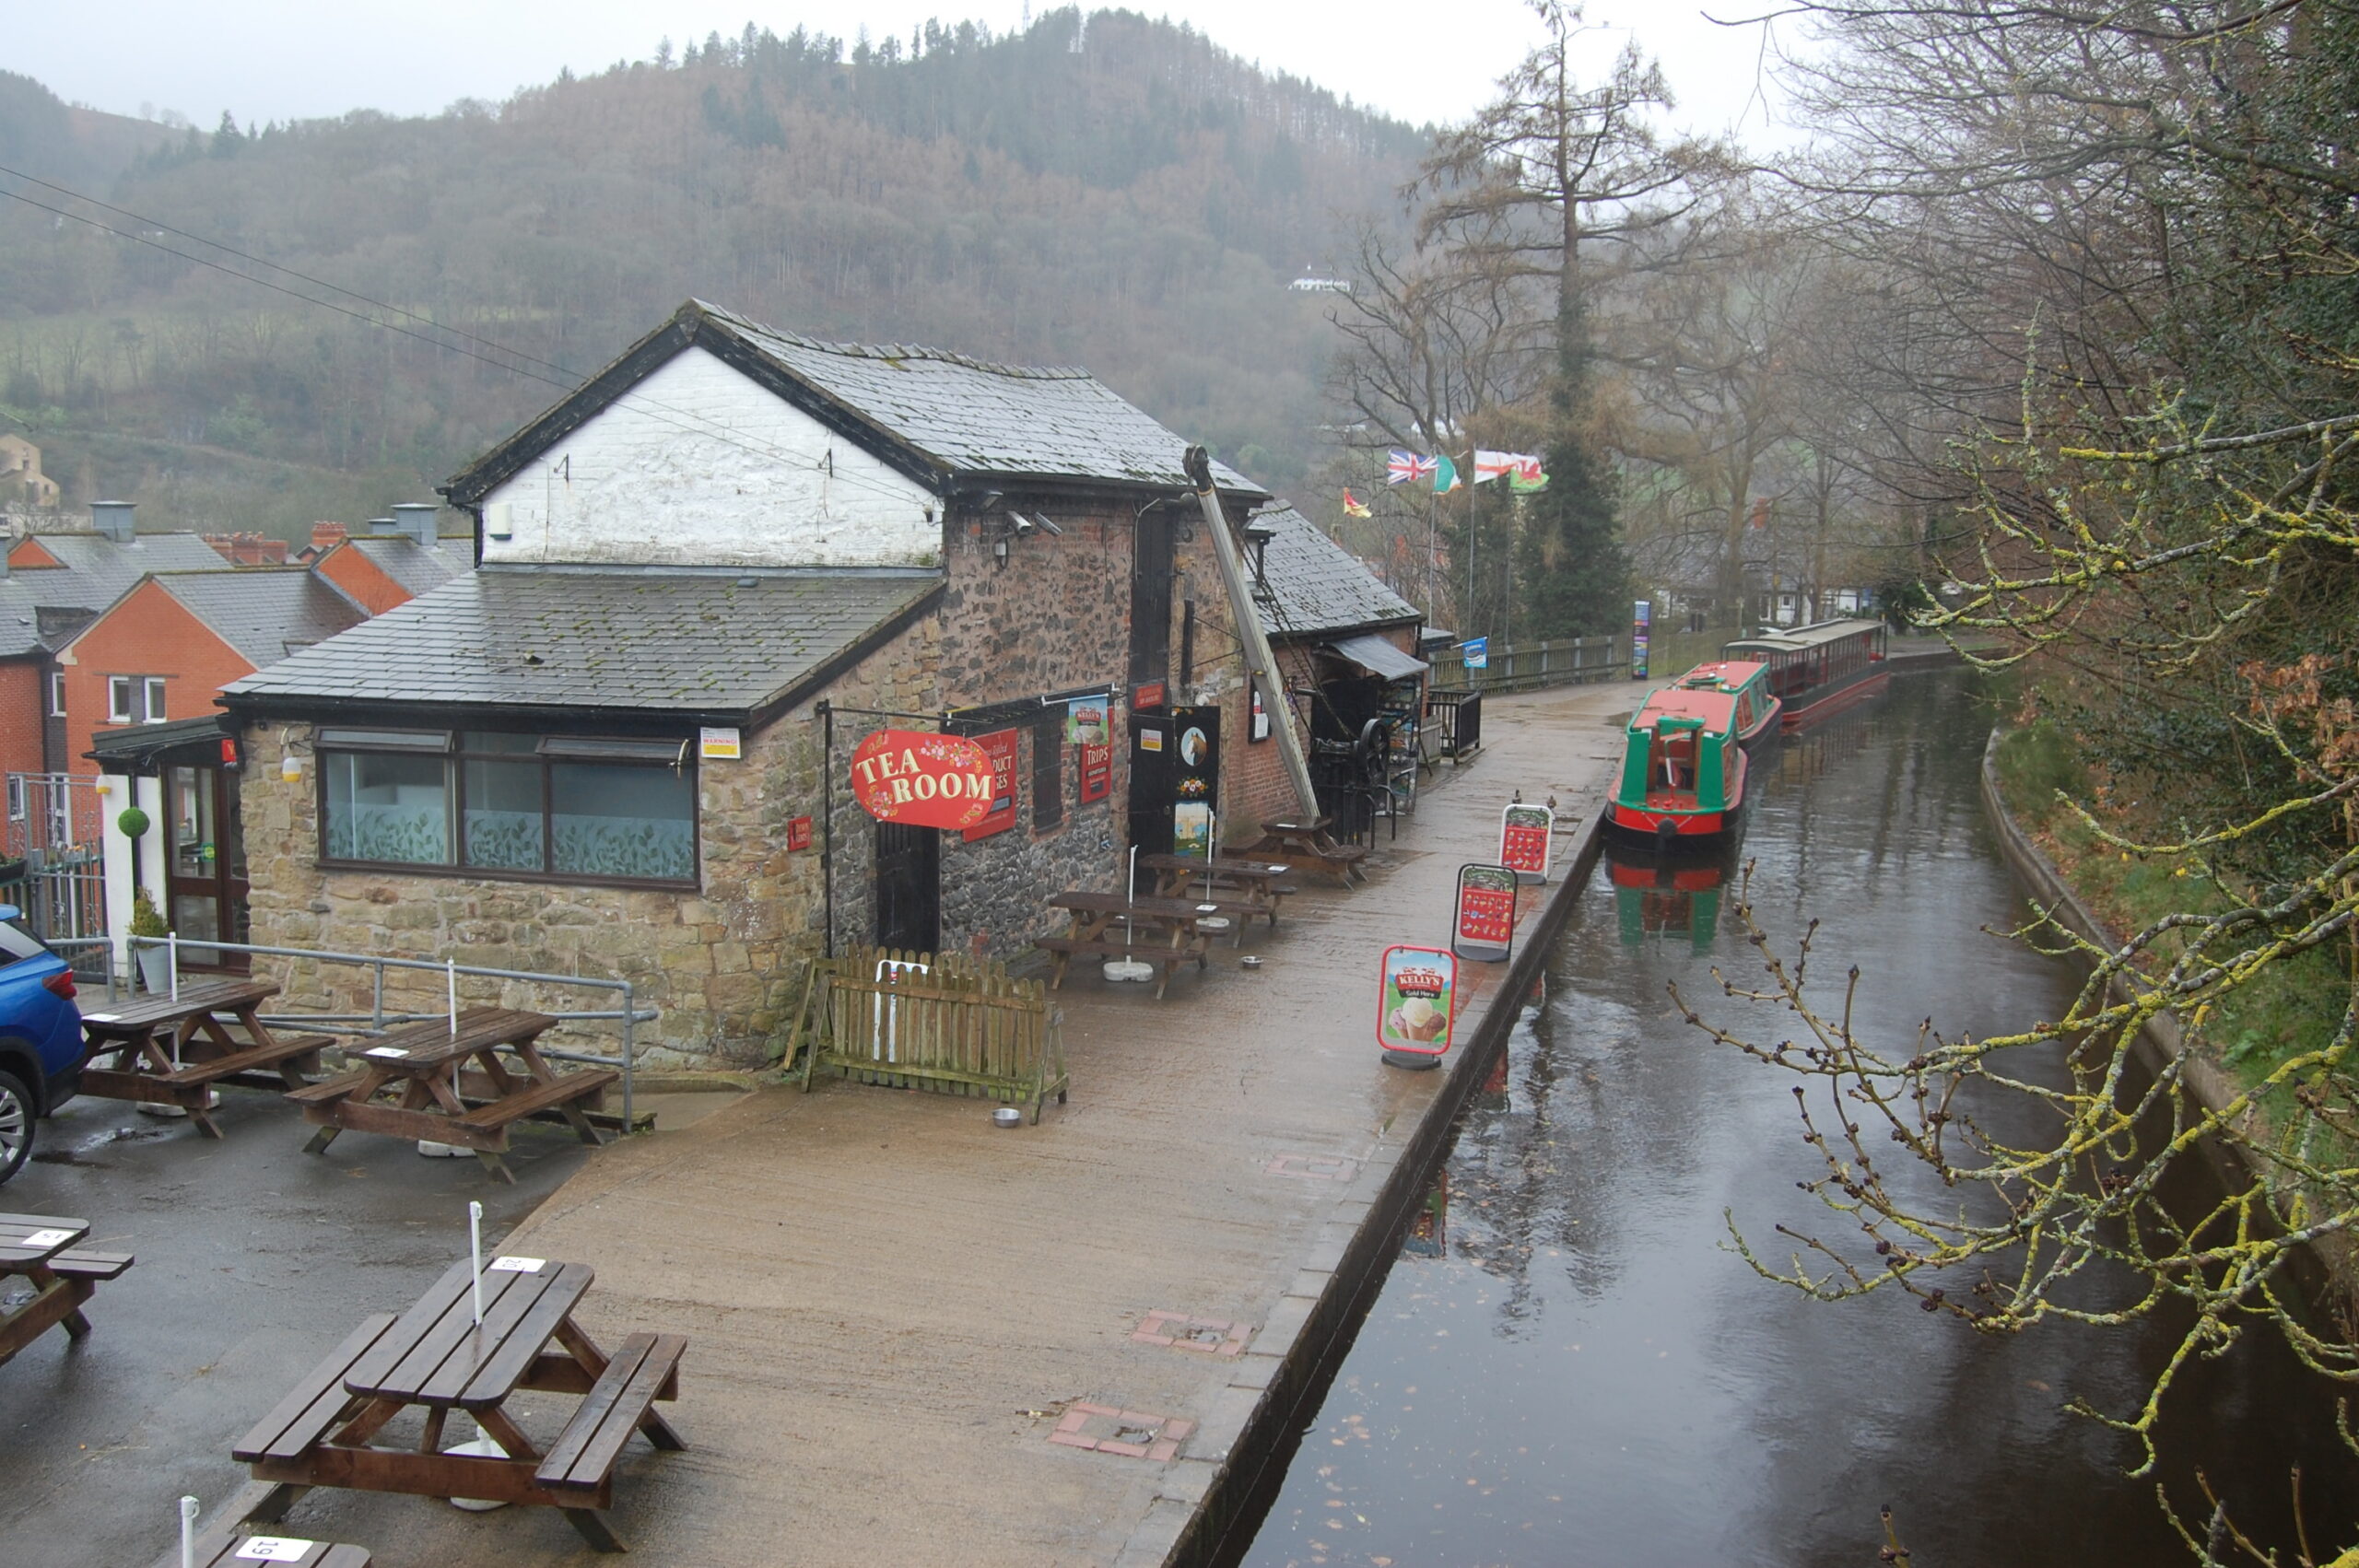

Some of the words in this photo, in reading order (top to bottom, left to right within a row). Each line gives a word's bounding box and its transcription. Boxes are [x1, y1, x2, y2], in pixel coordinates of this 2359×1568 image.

[1086, 746, 1109, 766] TRIPS
[856, 748, 921, 785] TEA
[890, 772, 992, 804] ROOM
[1399, 976, 1440, 986] KELLY'S
[252, 1541, 279, 1555] 19
